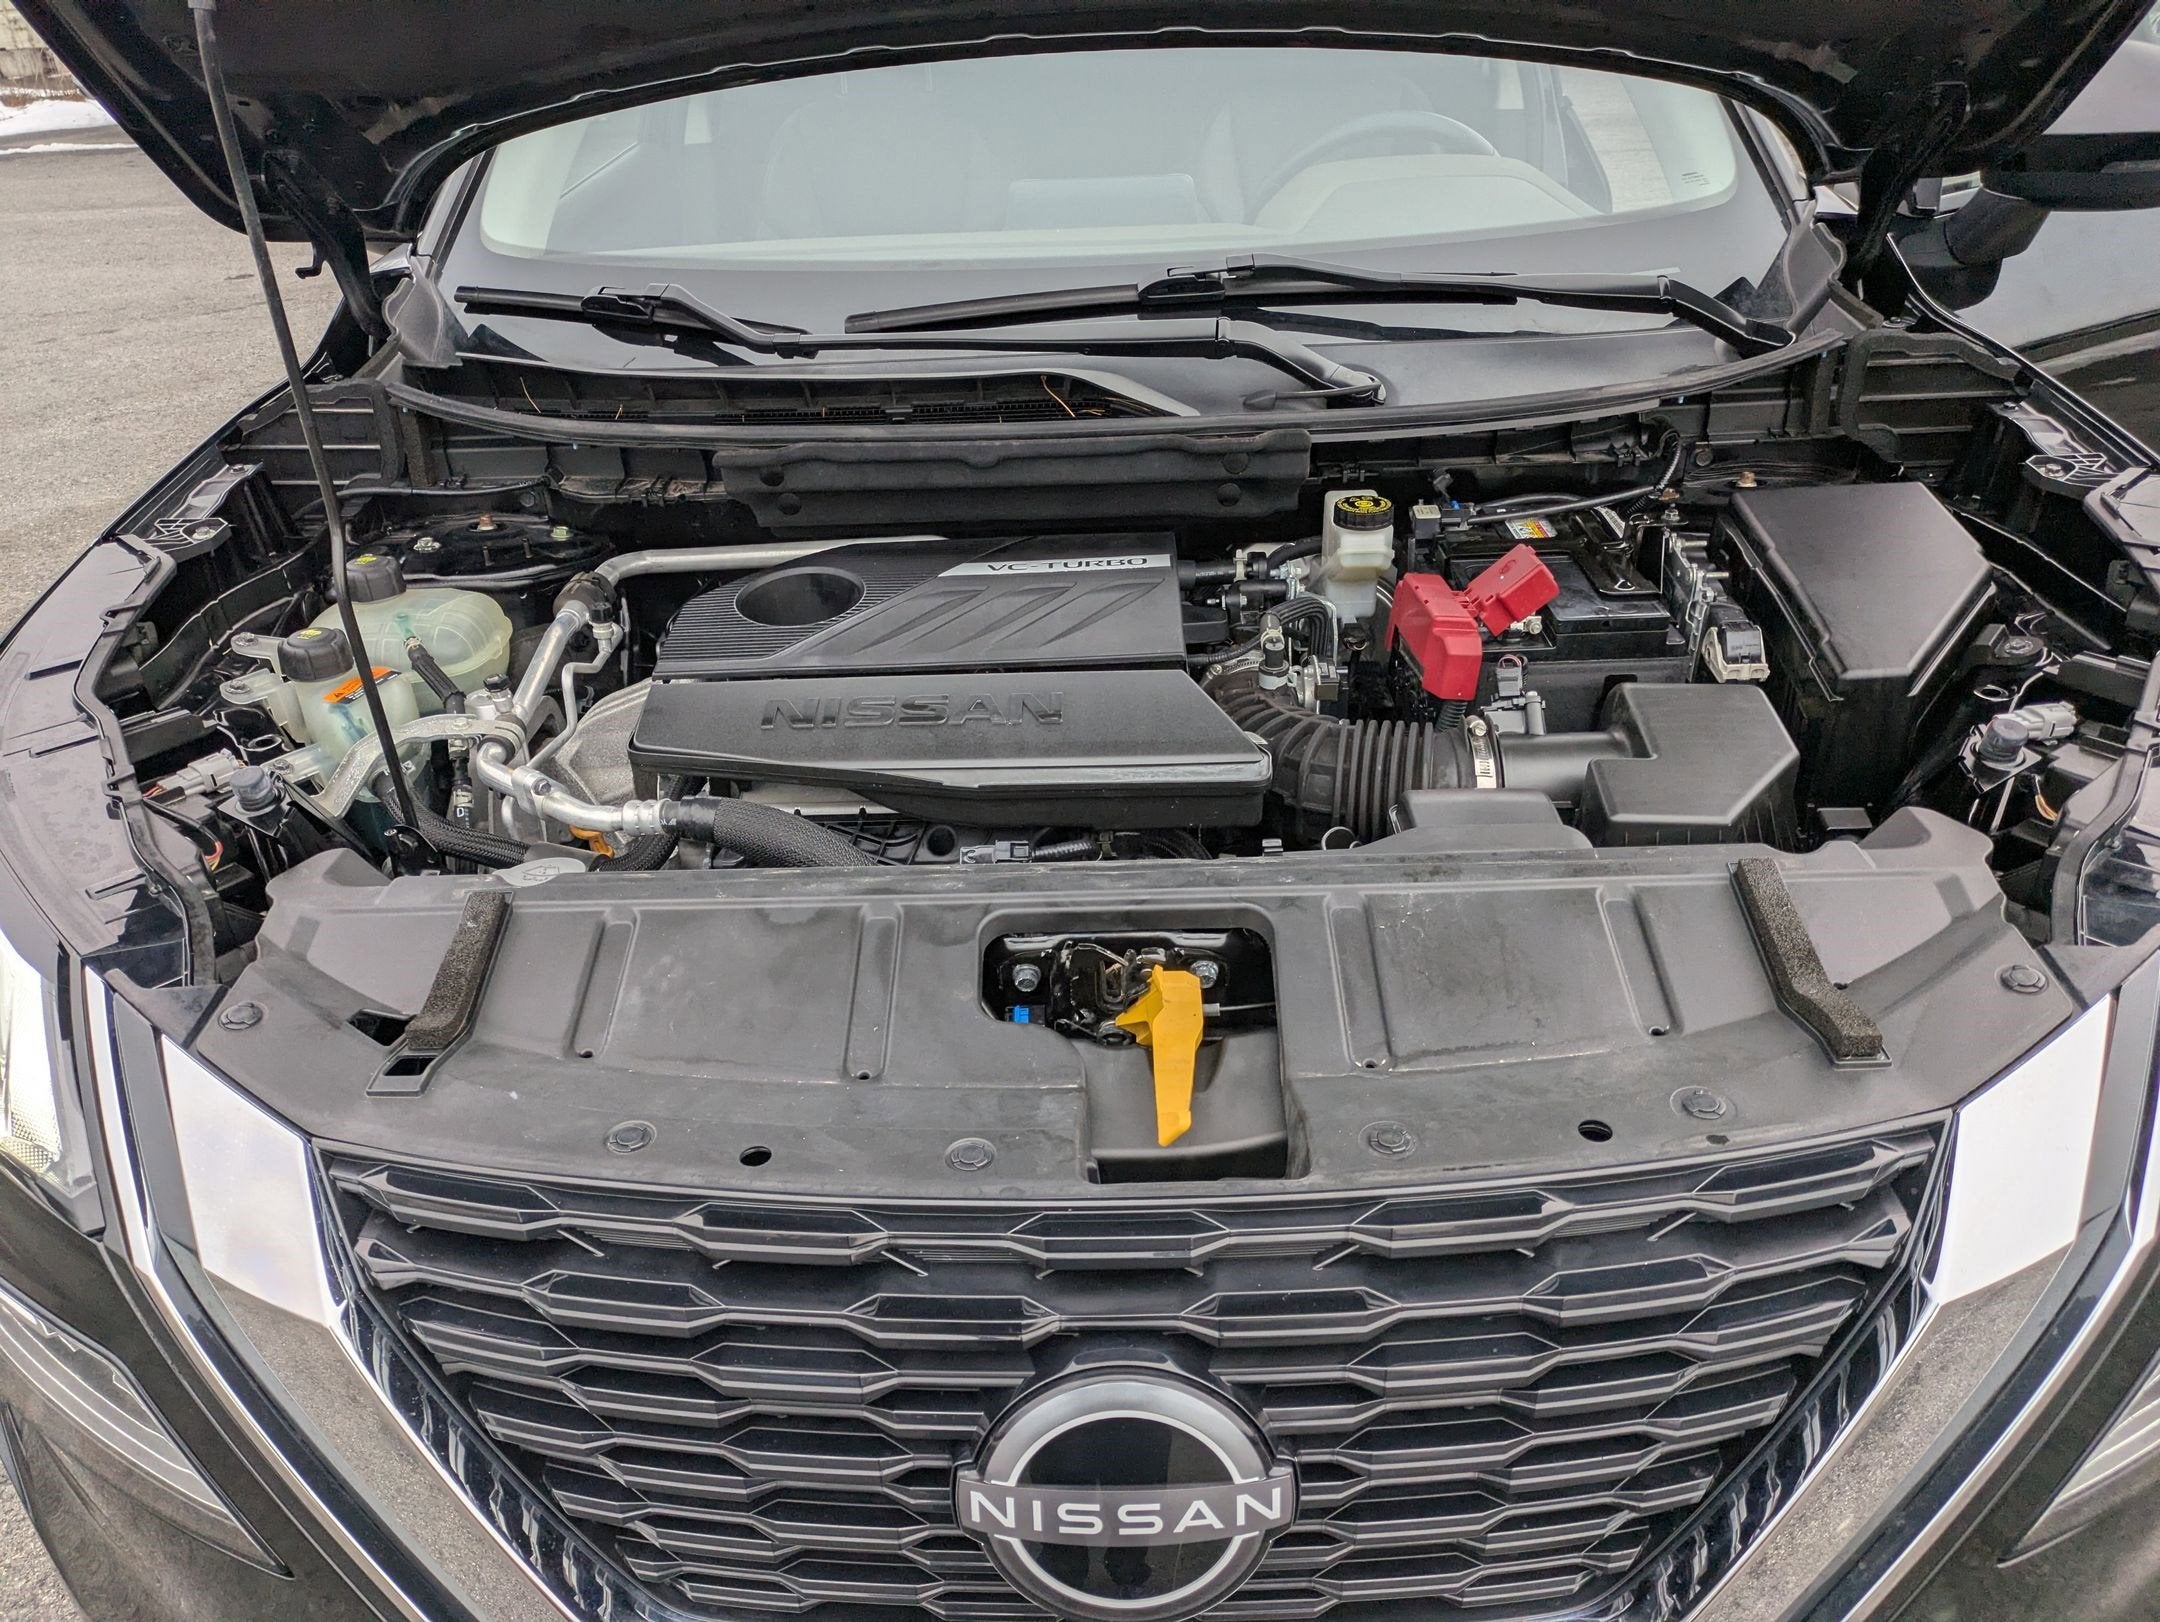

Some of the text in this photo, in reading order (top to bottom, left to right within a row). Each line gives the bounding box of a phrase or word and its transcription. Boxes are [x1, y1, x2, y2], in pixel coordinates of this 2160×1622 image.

[986, 556, 1148, 572] VC-TURBO
[760, 692, 1064, 730] NISSAN
[969, 1487, 1281, 1536] NISSAN
